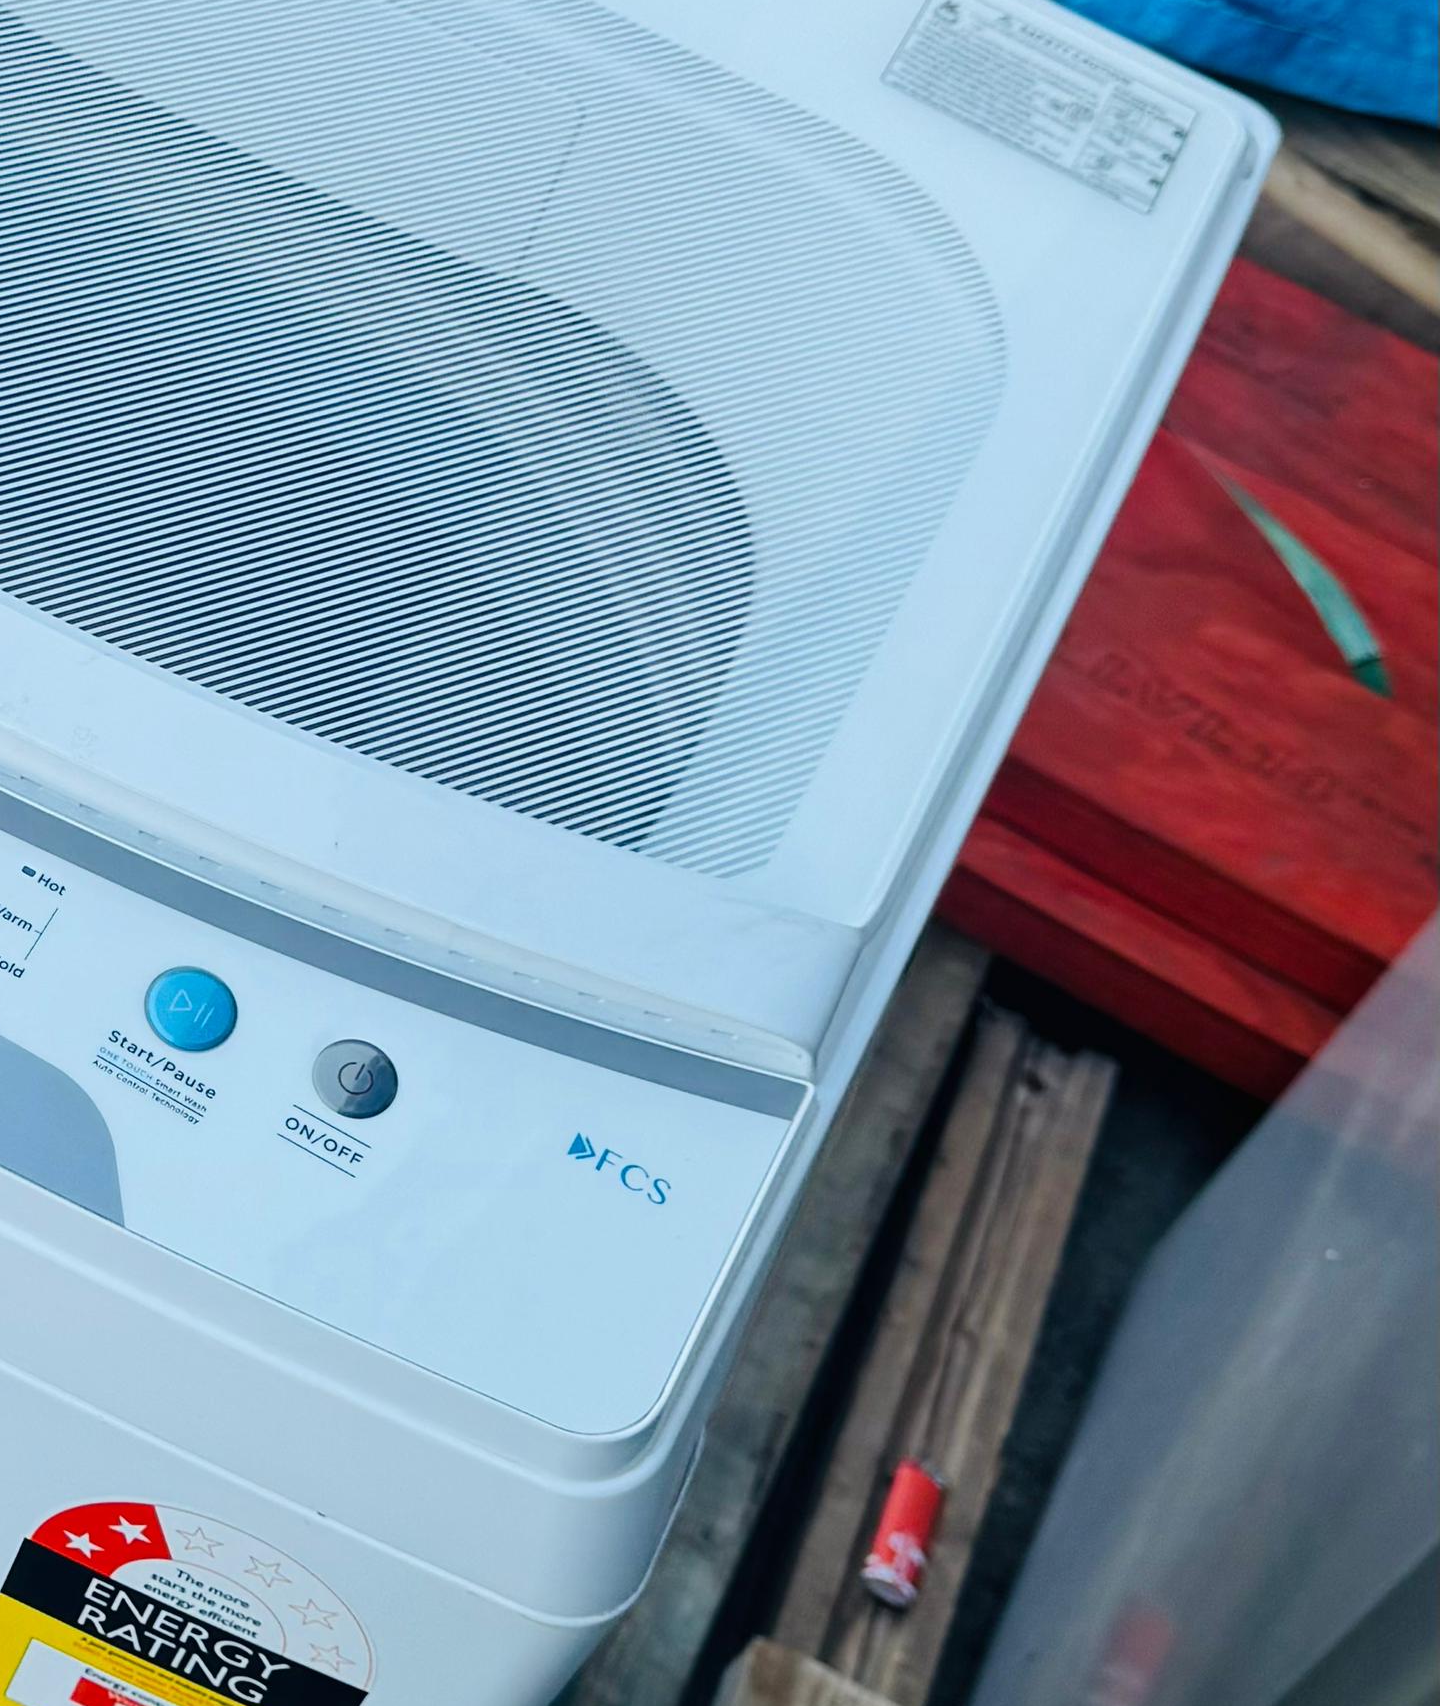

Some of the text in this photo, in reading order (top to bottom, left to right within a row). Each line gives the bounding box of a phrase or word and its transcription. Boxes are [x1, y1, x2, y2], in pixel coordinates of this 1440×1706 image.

[37, 874, 67, 896] Hot
[92, 1060, 200, 1125] Auto Control Technology
[99, 1047, 207, 1112] ONE TOUCH Smart Wash
[108, 1030, 216, 1099] Start/Pause
[285, 1117, 364, 1164] ON/OFF
[595, 1148, 671, 1204] FCS
[141, 1580, 259, 1639] energy efficient
[149, 1570, 264, 1628] stars the more
[172, 1567, 251, 1610] The more
[77, 1605, 268, 1704] RATING
[84, 1578, 291, 1680] ENERGY
[83, 1667, 129, 1693] Energy
